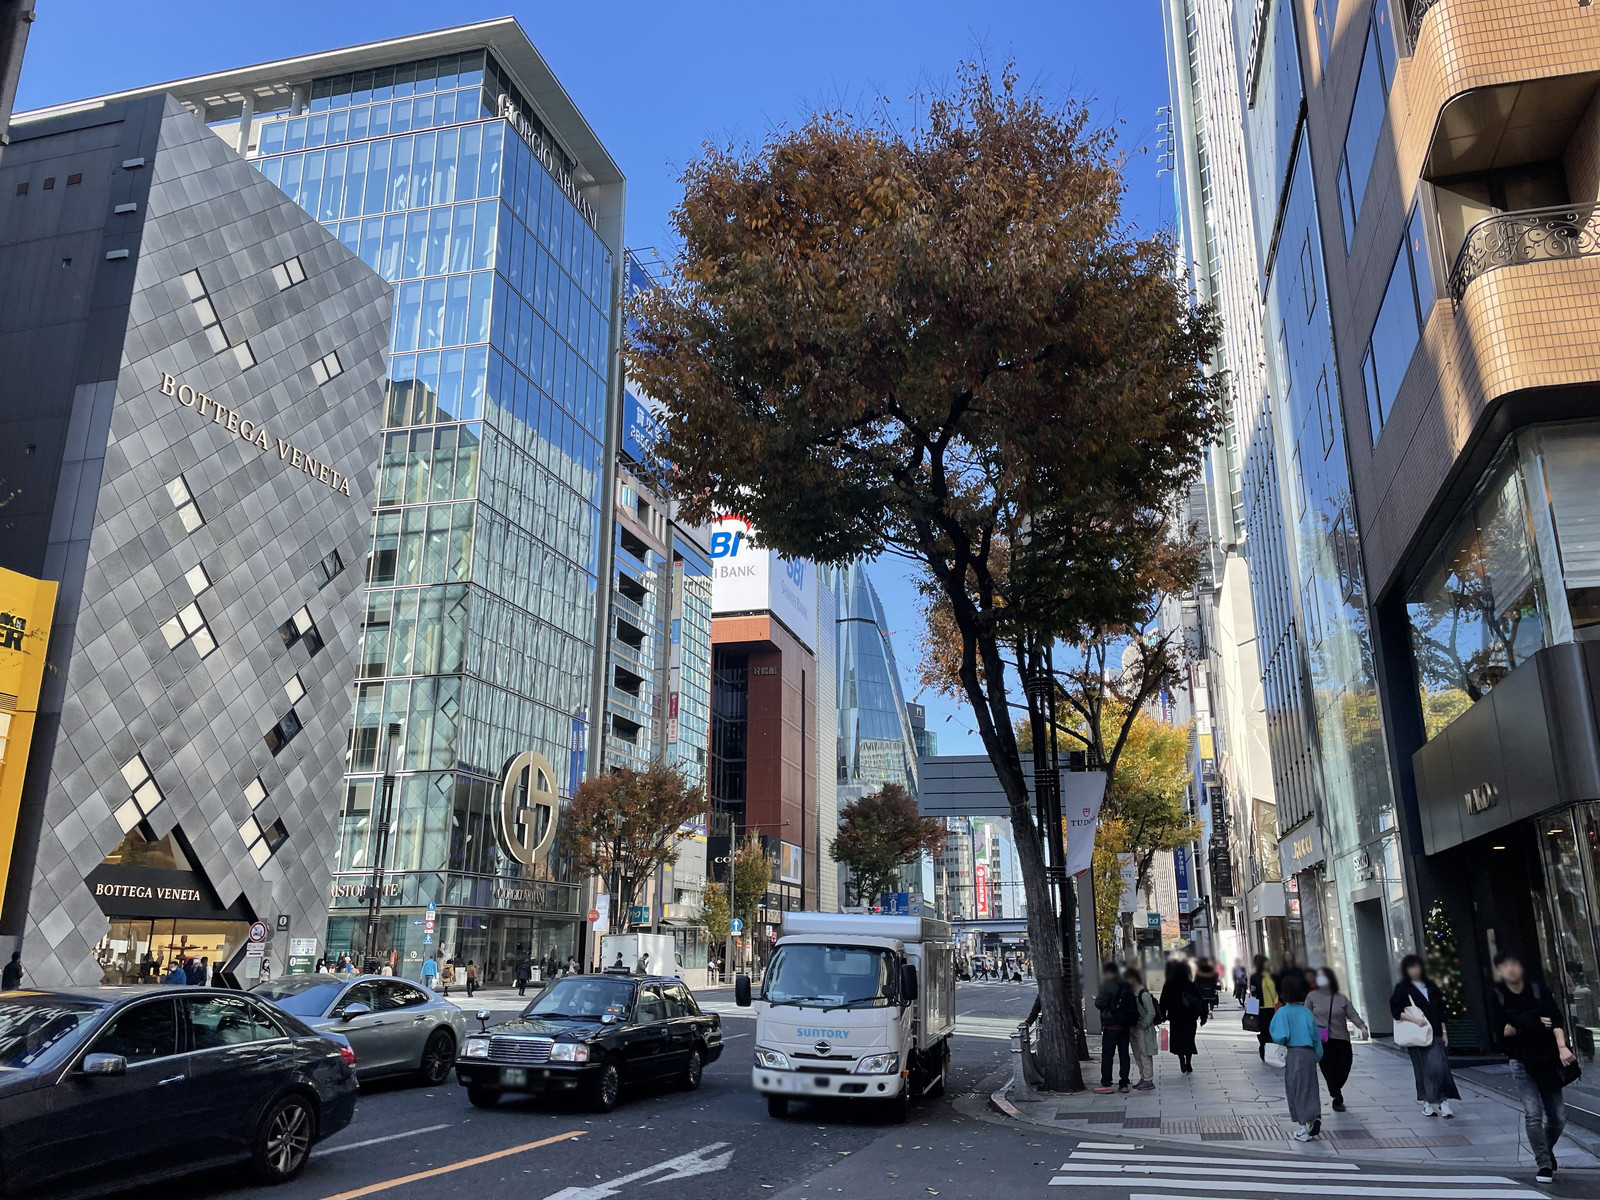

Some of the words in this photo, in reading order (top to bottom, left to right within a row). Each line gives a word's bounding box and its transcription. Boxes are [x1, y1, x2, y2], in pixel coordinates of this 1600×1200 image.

[498, 94, 553, 171] GIORGIO
[555, 168, 597, 229] ARMANI
[160, 373, 269, 451] BOTTEGA
[276, 438, 351, 497] VENETA
[710, 531, 742, 558] BI
[720, 565, 755, 578] BANK
[95, 883, 152, 898] BOTTEGA
[157, 887, 201, 901] VENETA
[330, 883, 399, 898] RISTORTE
[796, 1028, 850, 1039] SUNTORY
